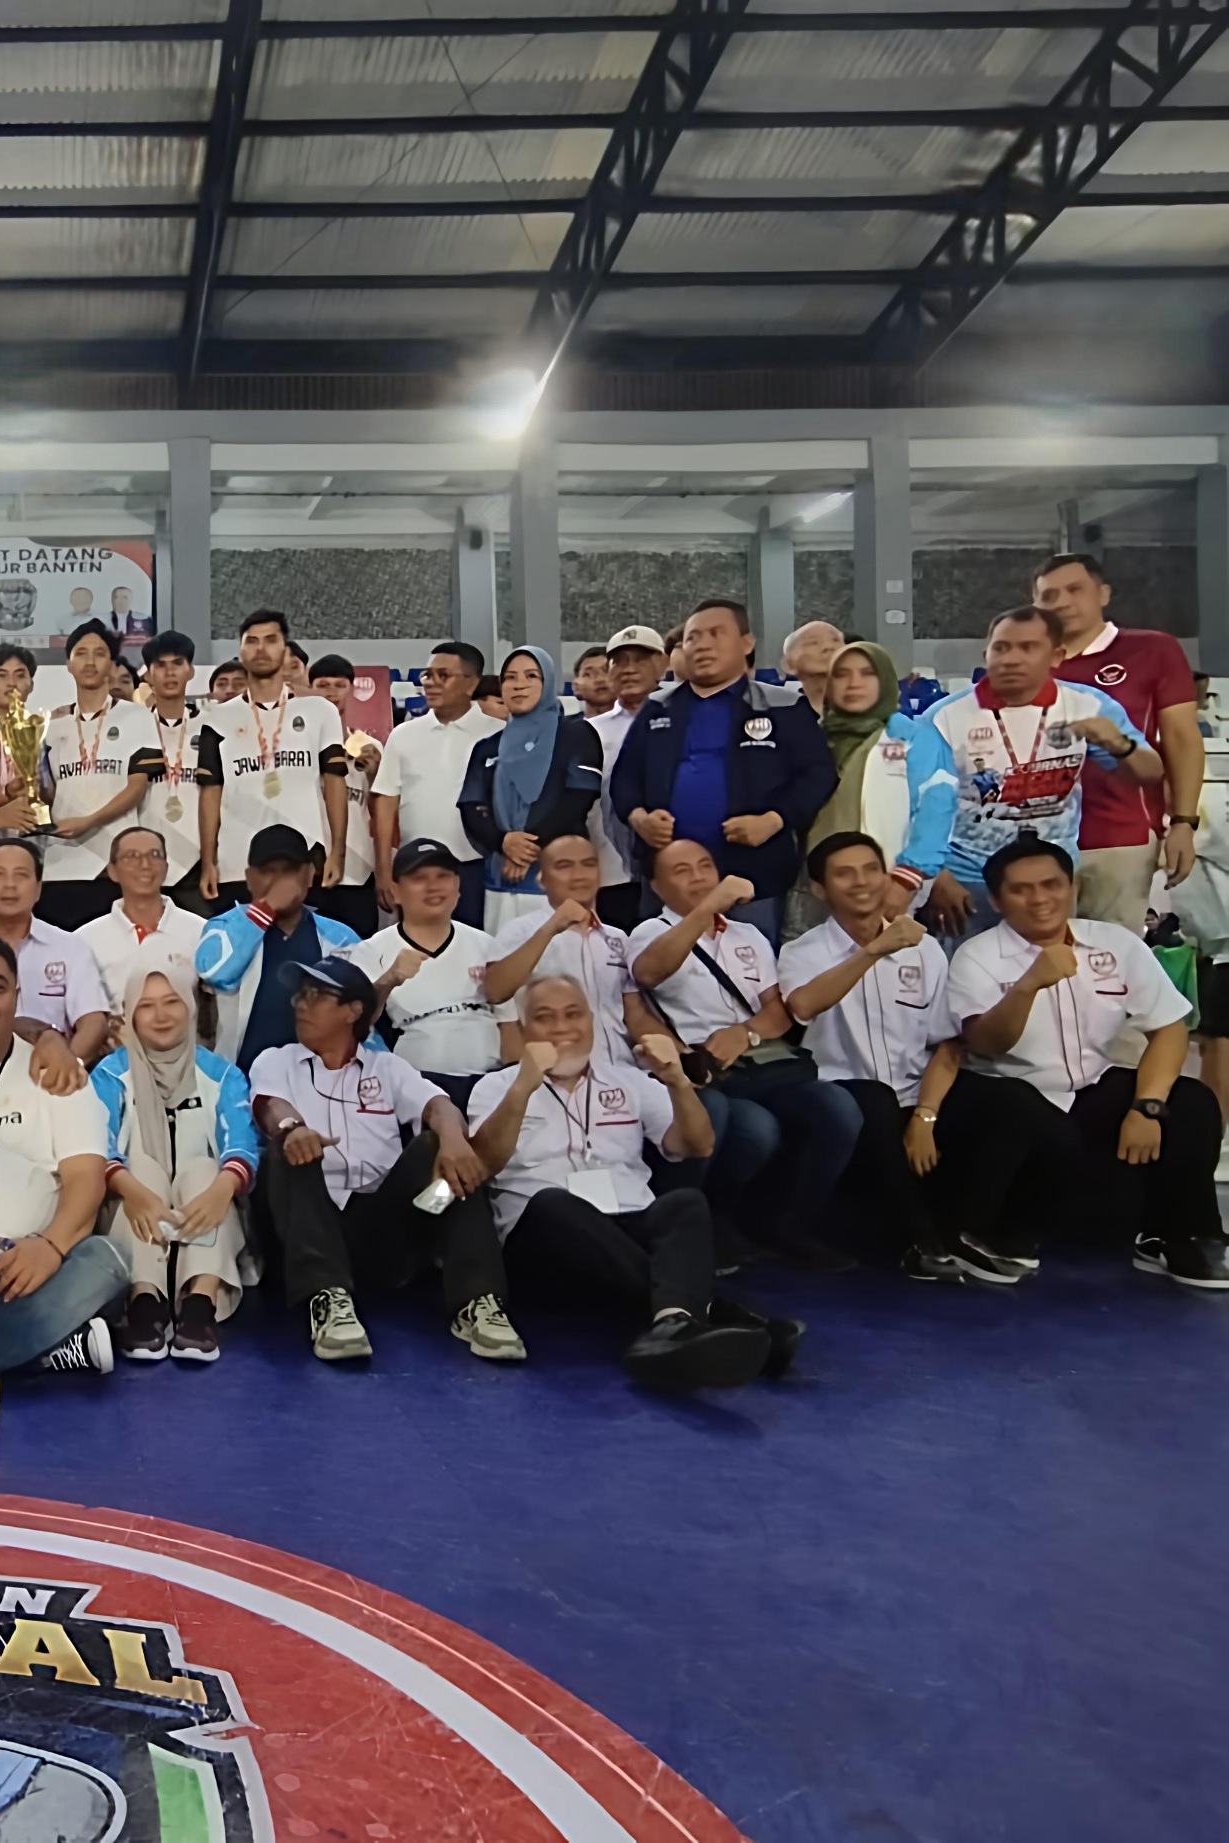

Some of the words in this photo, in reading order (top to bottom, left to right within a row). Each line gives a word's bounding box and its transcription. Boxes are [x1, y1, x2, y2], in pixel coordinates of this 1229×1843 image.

[18, 547, 113, 561] DATANG
[26, 561, 103, 574] BANTEN
[94, 759, 123, 775] ARAT
